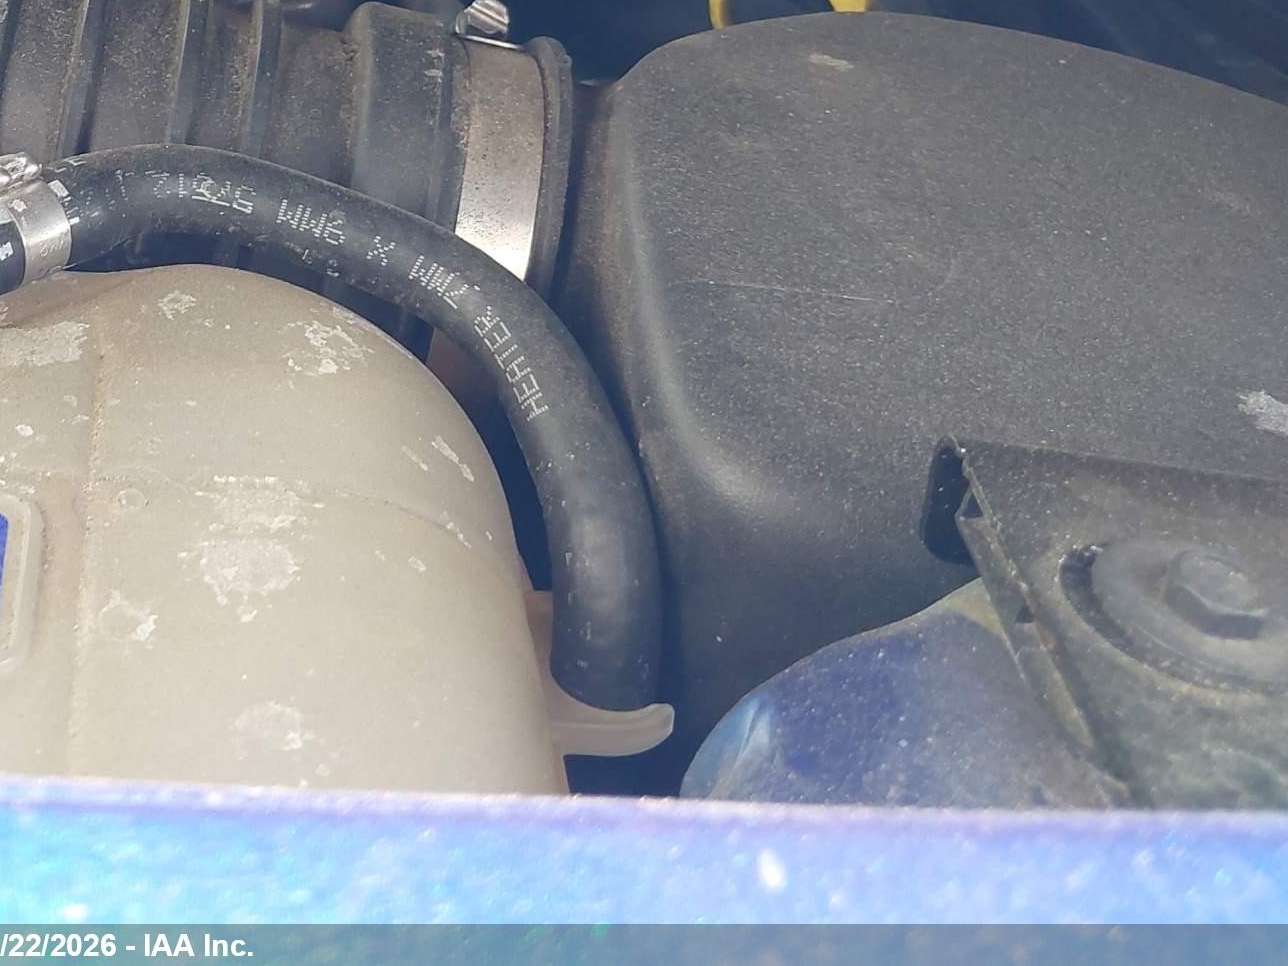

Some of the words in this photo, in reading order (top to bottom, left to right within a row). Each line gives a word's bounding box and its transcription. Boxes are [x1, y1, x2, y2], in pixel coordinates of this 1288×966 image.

[276, 198, 346, 246] 9MM
[365, 235, 397, 267] X
[408, 255, 481, 309] 7MM
[473, 305, 549, 422] HEATER
